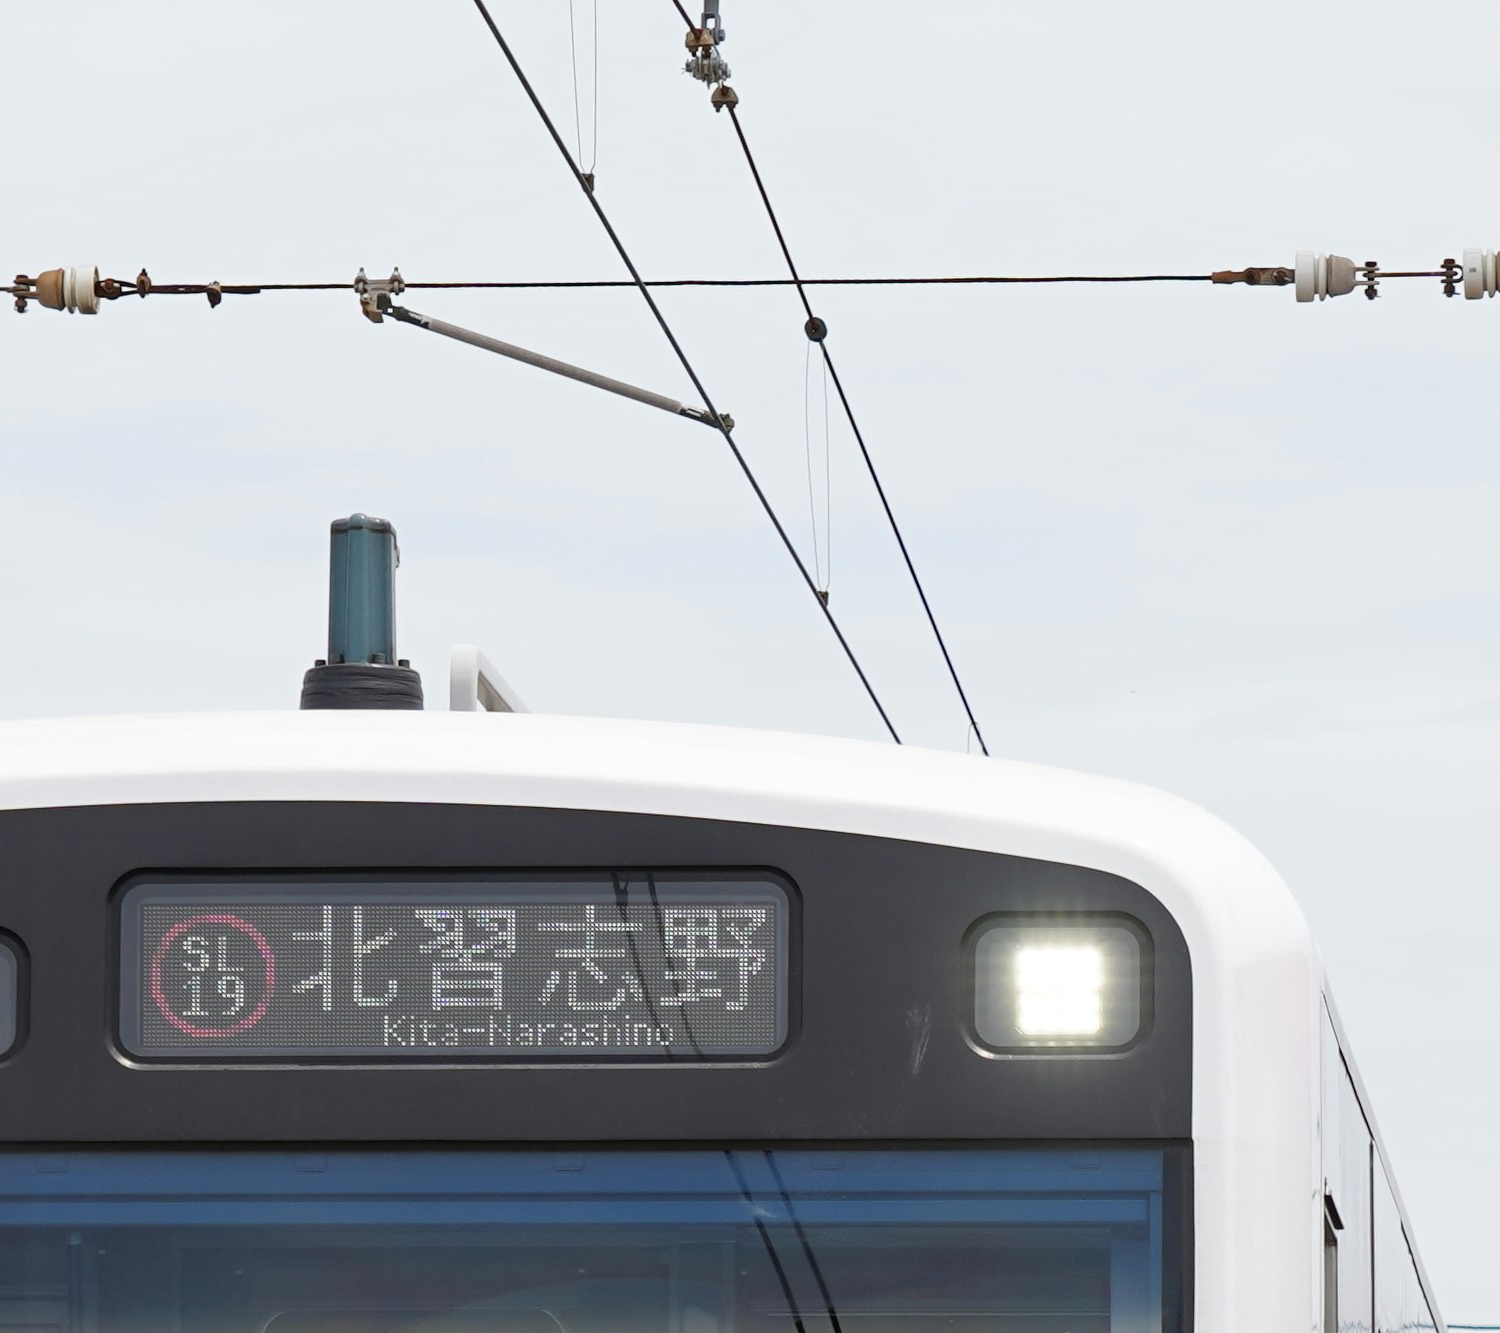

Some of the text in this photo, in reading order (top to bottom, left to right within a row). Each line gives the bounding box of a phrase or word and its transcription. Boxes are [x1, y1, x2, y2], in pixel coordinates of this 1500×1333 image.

[182, 936, 244, 972] SL
[292, 905, 767, 1012] 北習志野
[182, 975, 244, 1016] 19
[383, 1015, 674, 1046] Kita-Narashino
